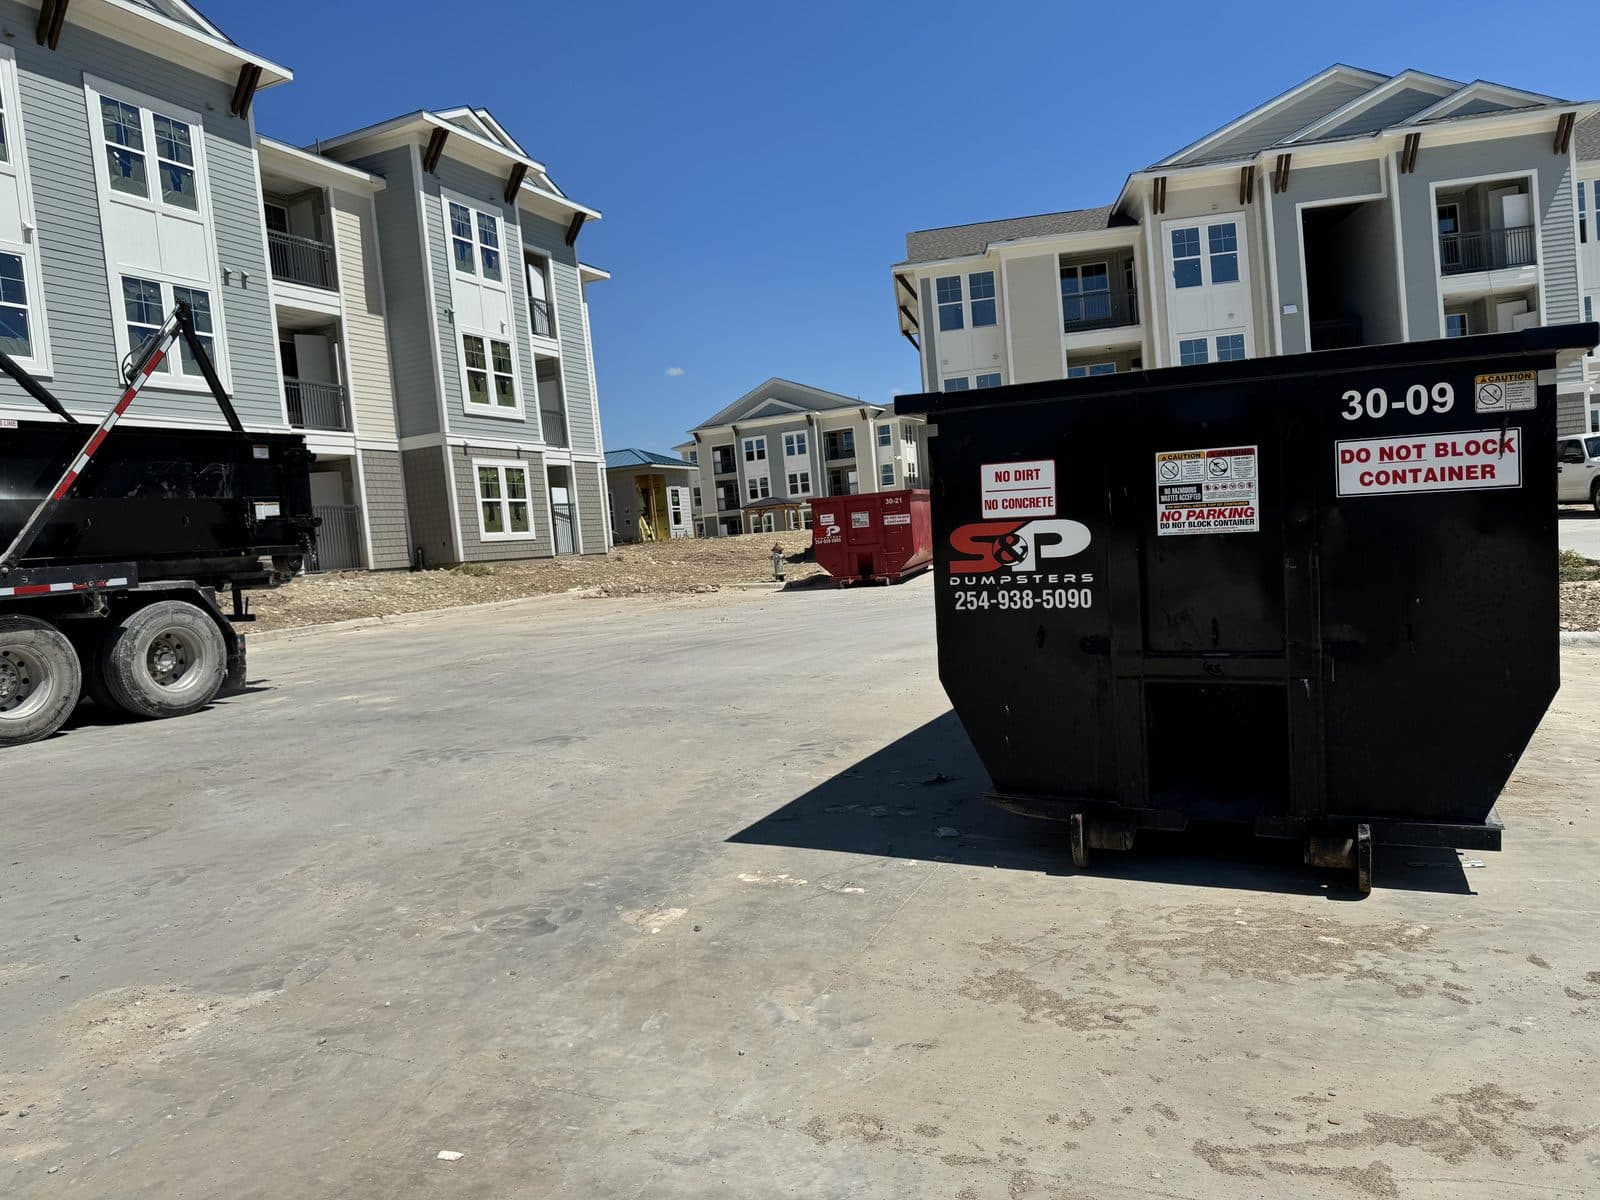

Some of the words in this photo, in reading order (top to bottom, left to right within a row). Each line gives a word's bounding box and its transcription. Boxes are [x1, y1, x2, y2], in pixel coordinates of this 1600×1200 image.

[1488, 373, 1531, 382] CAUTION
[1341, 382, 1455, 420] 30-09
[1340, 448, 1371, 464] DO
[1379, 444, 1427, 461] NOT
[1434, 437, 1516, 457] BLOCK
[995, 470, 1010, 483] NO
[1014, 469, 1040, 481] DIRT
[1359, 464, 1496, 487] CONTAINER
[984, 500, 998, 510] NO
[1001, 496, 1054, 510] CONCRETE
[1160, 511, 1182, 522] NO
[1186, 507, 1255, 521] PARKING
[1172, 521, 1186, 529] NOT
[1188, 520, 1212, 528] BLOCK
[1214, 518, 1255, 527] CONTAINER
[949, 519, 1092, 574] S&P
[950, 574, 1094, 586] DUMPSTERS
[954, 589, 1092, 610] 254-938-5090
